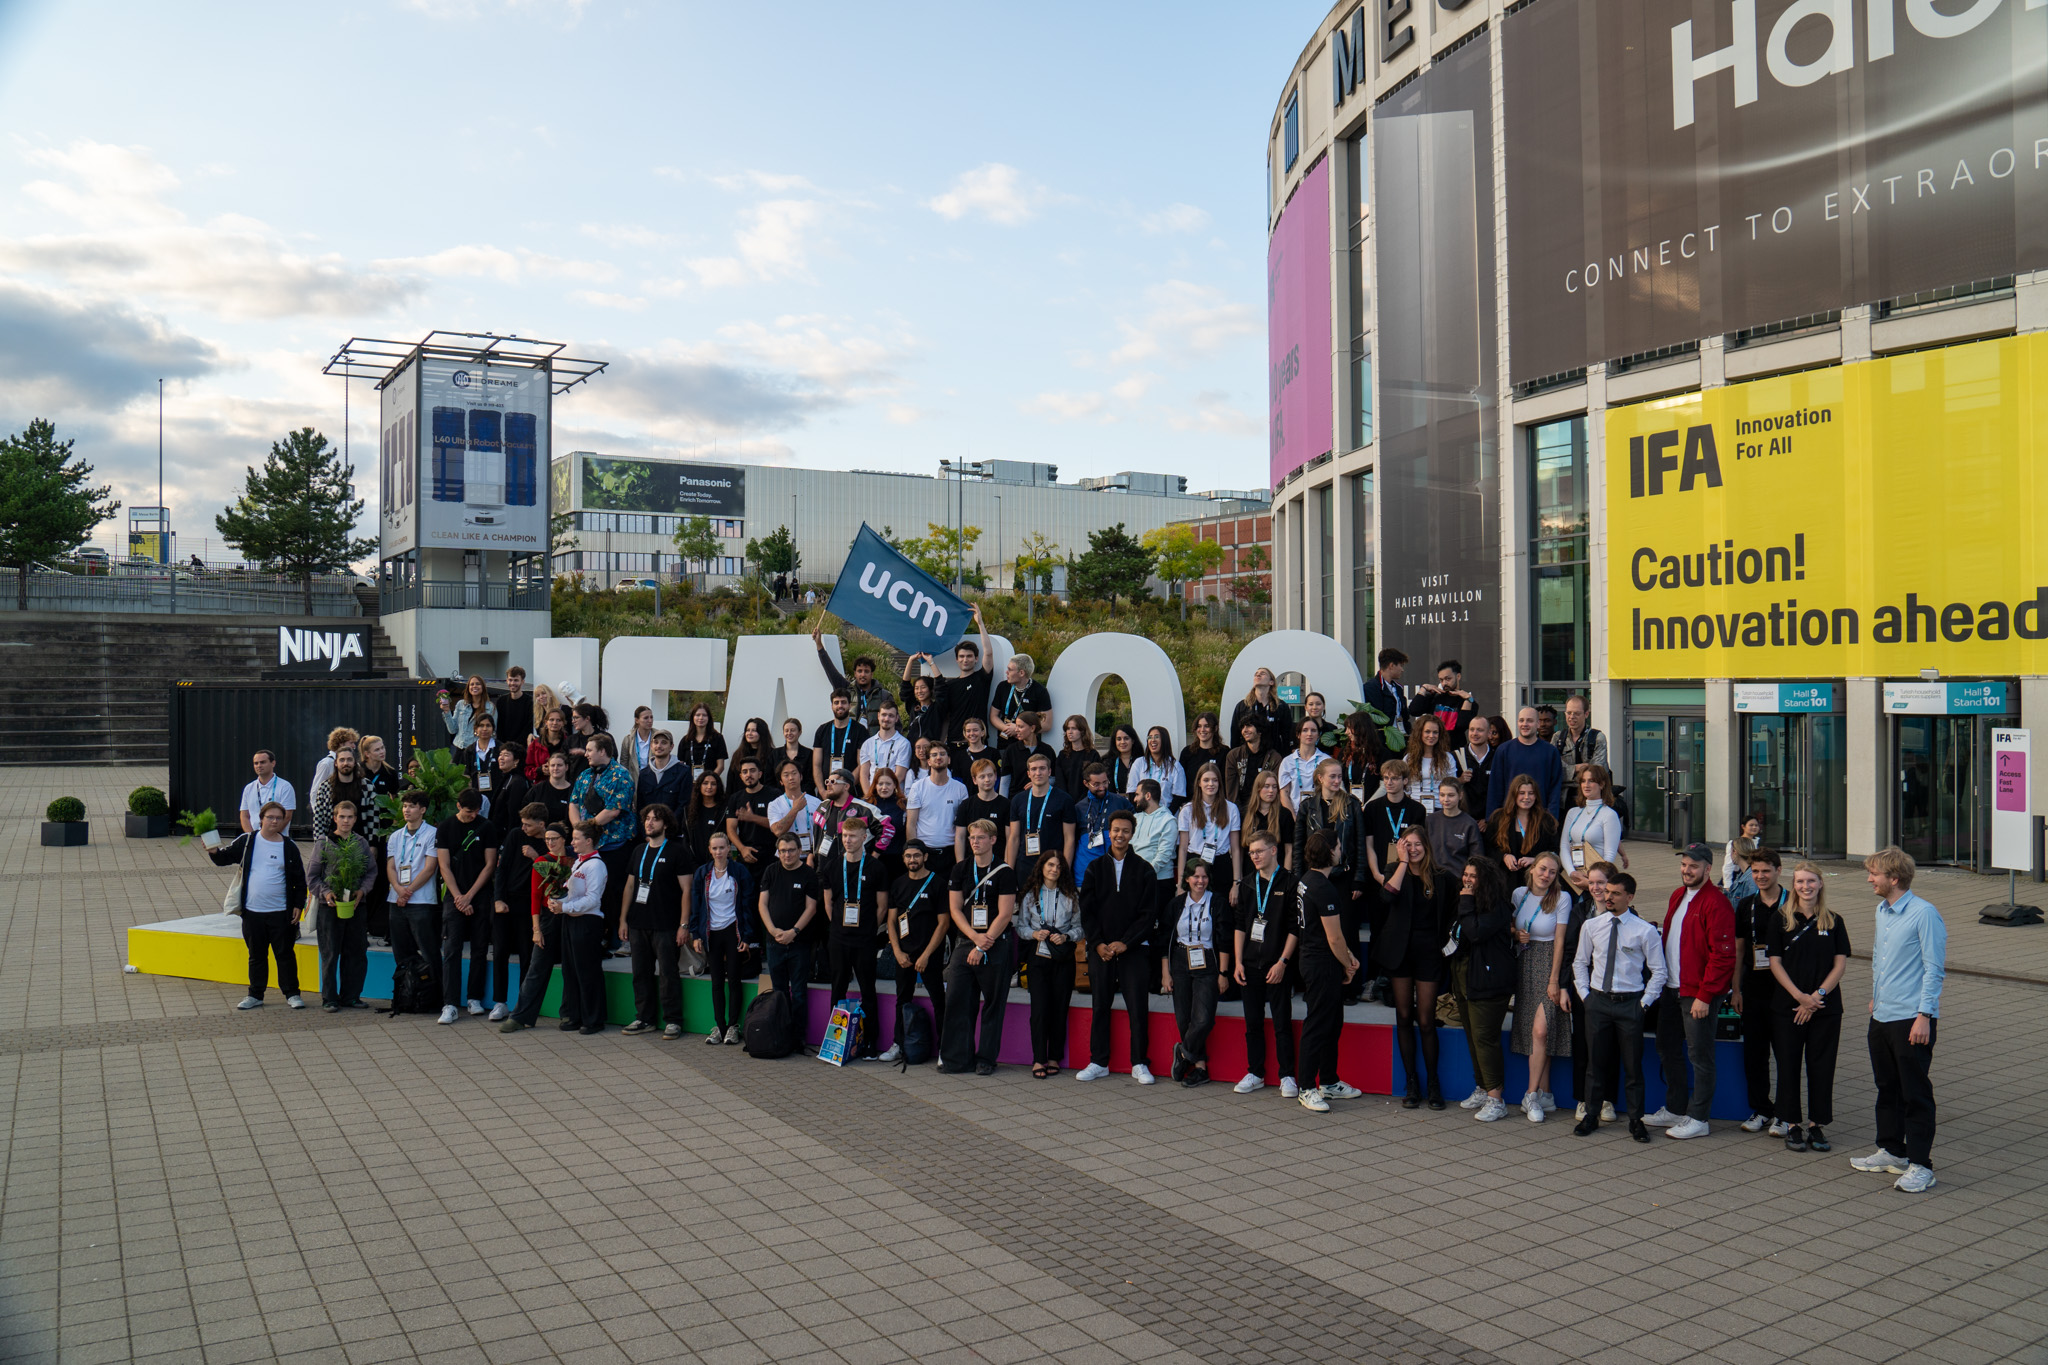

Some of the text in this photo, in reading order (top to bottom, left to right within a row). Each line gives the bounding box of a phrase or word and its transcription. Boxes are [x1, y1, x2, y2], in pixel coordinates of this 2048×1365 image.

[1565, 224, 1720, 293] CONNECT
[1745, 206, 1793, 240] TO
[1278, 343, 1299, 405] years
[1736, 407, 1832, 436] Innovation
[434, 435, 450, 444] L40
[474, 438, 500, 447] Robot
[1736, 435, 1792, 460] For All
[1630, 423, 1723, 499] IFA
[680, 475, 732, 488] Panasonic
[431, 531, 537, 543] CLEAN LIKE A CHAMPION
[1631, 533, 1805, 591] Caution!
[1421, 574, 1449, 588] VISIT
[859, 561, 948, 637] ucm
[1395, 589, 1482, 609] HAIER PAVILLON
[1405, 610, 1469, 626] AT HALL 3.1
[1632, 586, 2048, 651] Innovation ahead
[280, 625, 364, 672] NINJA
[1810, 688, 1818, 697] 9
[1964, 686, 1991, 696] Hall 9
[1784, 698, 1826, 707] Stand 101
[1954, 697, 2000, 707] Stand 101
[1996, 733, 2012, 743] IFA
[1999, 770, 2022, 778] Access
[1999, 778, 2012, 786] Fast
